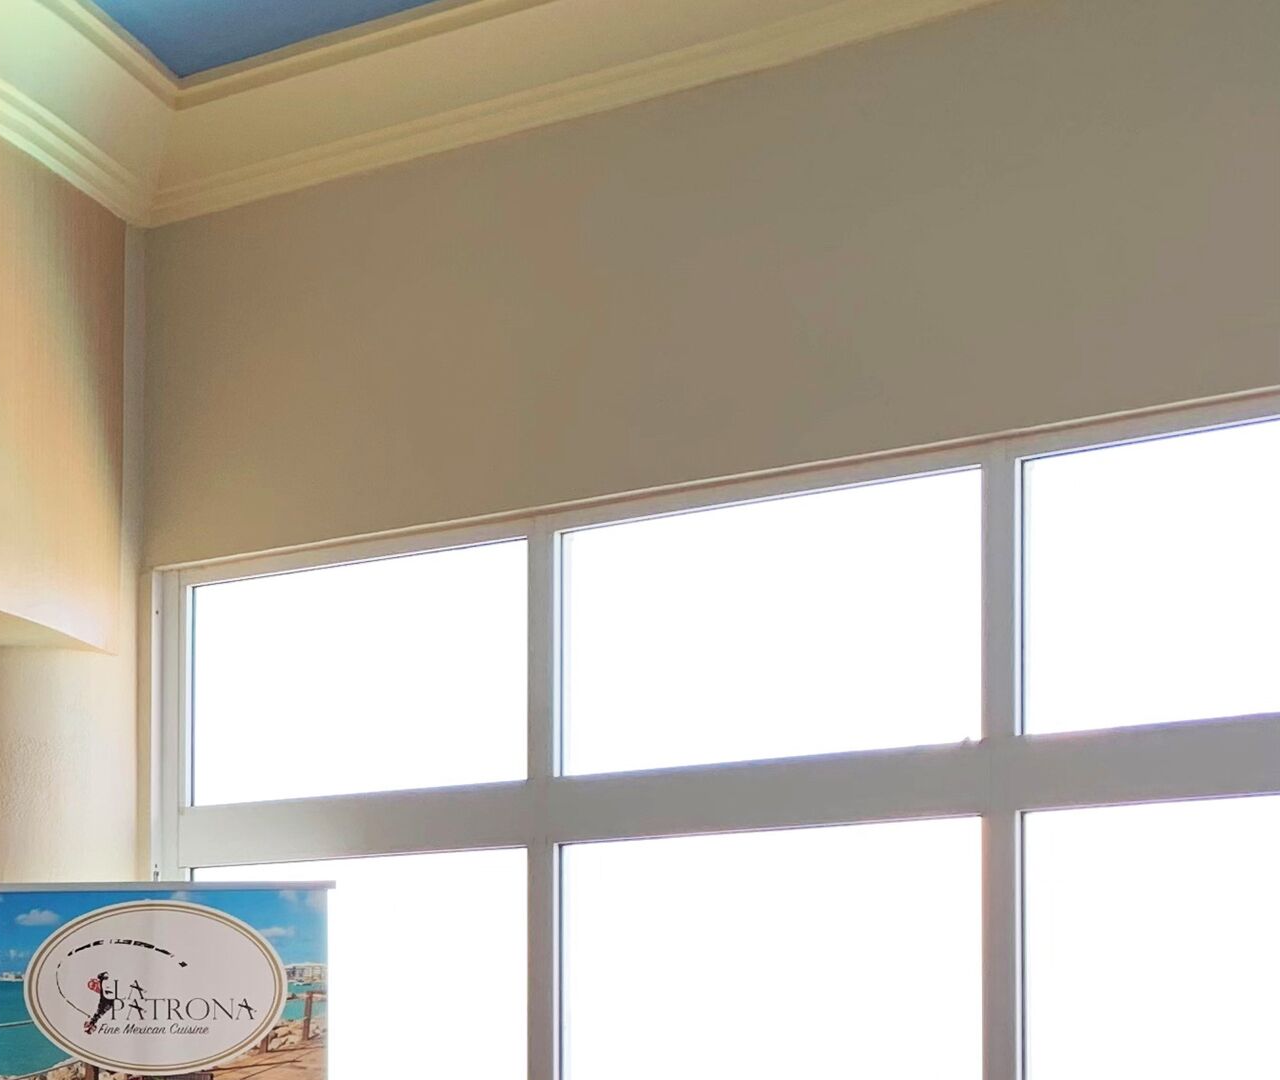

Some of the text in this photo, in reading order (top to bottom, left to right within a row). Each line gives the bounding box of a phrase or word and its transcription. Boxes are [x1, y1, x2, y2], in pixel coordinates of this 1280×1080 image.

[113, 979, 146, 1000] LA
[110, 998, 256, 1021] PATRONA
[98, 1023, 210, 1035] Fine Mexican Cuisine
